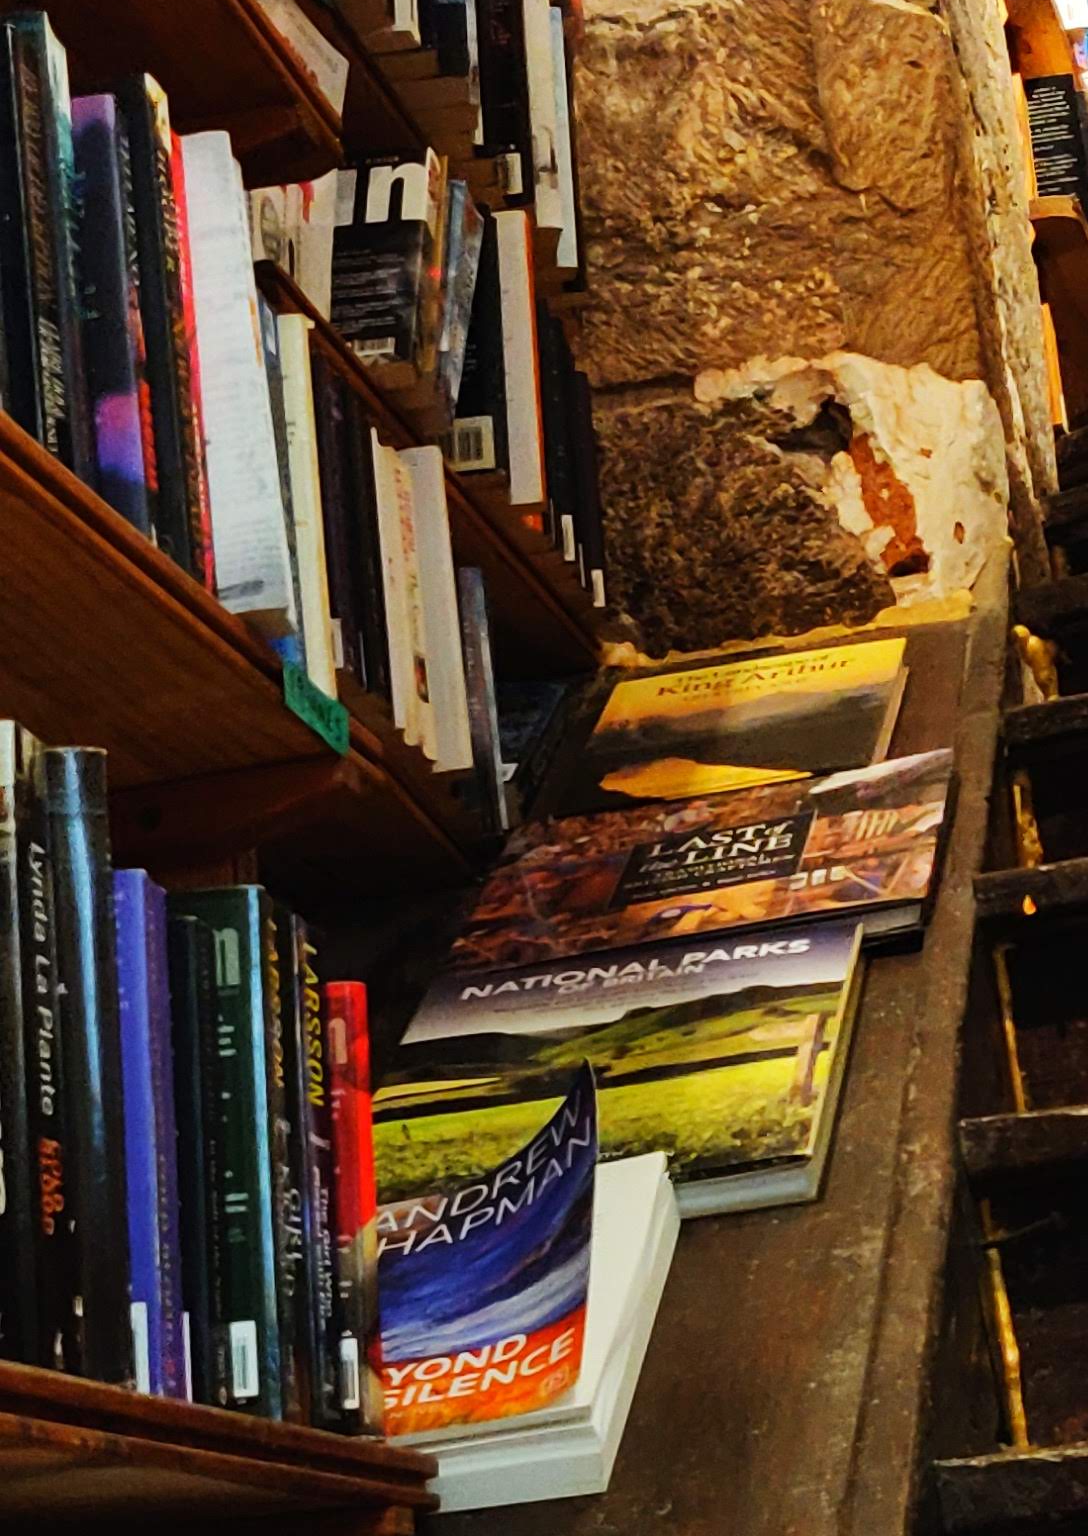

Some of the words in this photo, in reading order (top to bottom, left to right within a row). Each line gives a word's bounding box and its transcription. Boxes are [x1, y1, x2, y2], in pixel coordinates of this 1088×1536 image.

[657, 678, 735, 697] King
[741, 659, 850, 685] Arthur
[648, 823, 767, 858] LAST
[683, 832, 794, 866] LINE
[28, 842, 50, 943] Lynda
[34, 955, 52, 994] La
[459, 958, 669, 1001] NATIONAL
[680, 939, 812, 966] PARKS
[556, 979, 596, 996] OF
[602, 962, 707, 990] BRITAIN
[301, 942, 327, 1107] LARSSON
[38, 1006, 56, 1116] Plante
[375, 1089, 585, 1234] ANDREW
[378, 1116, 593, 1258] HAPMAN
[385, 1332, 526, 1387] YOND
